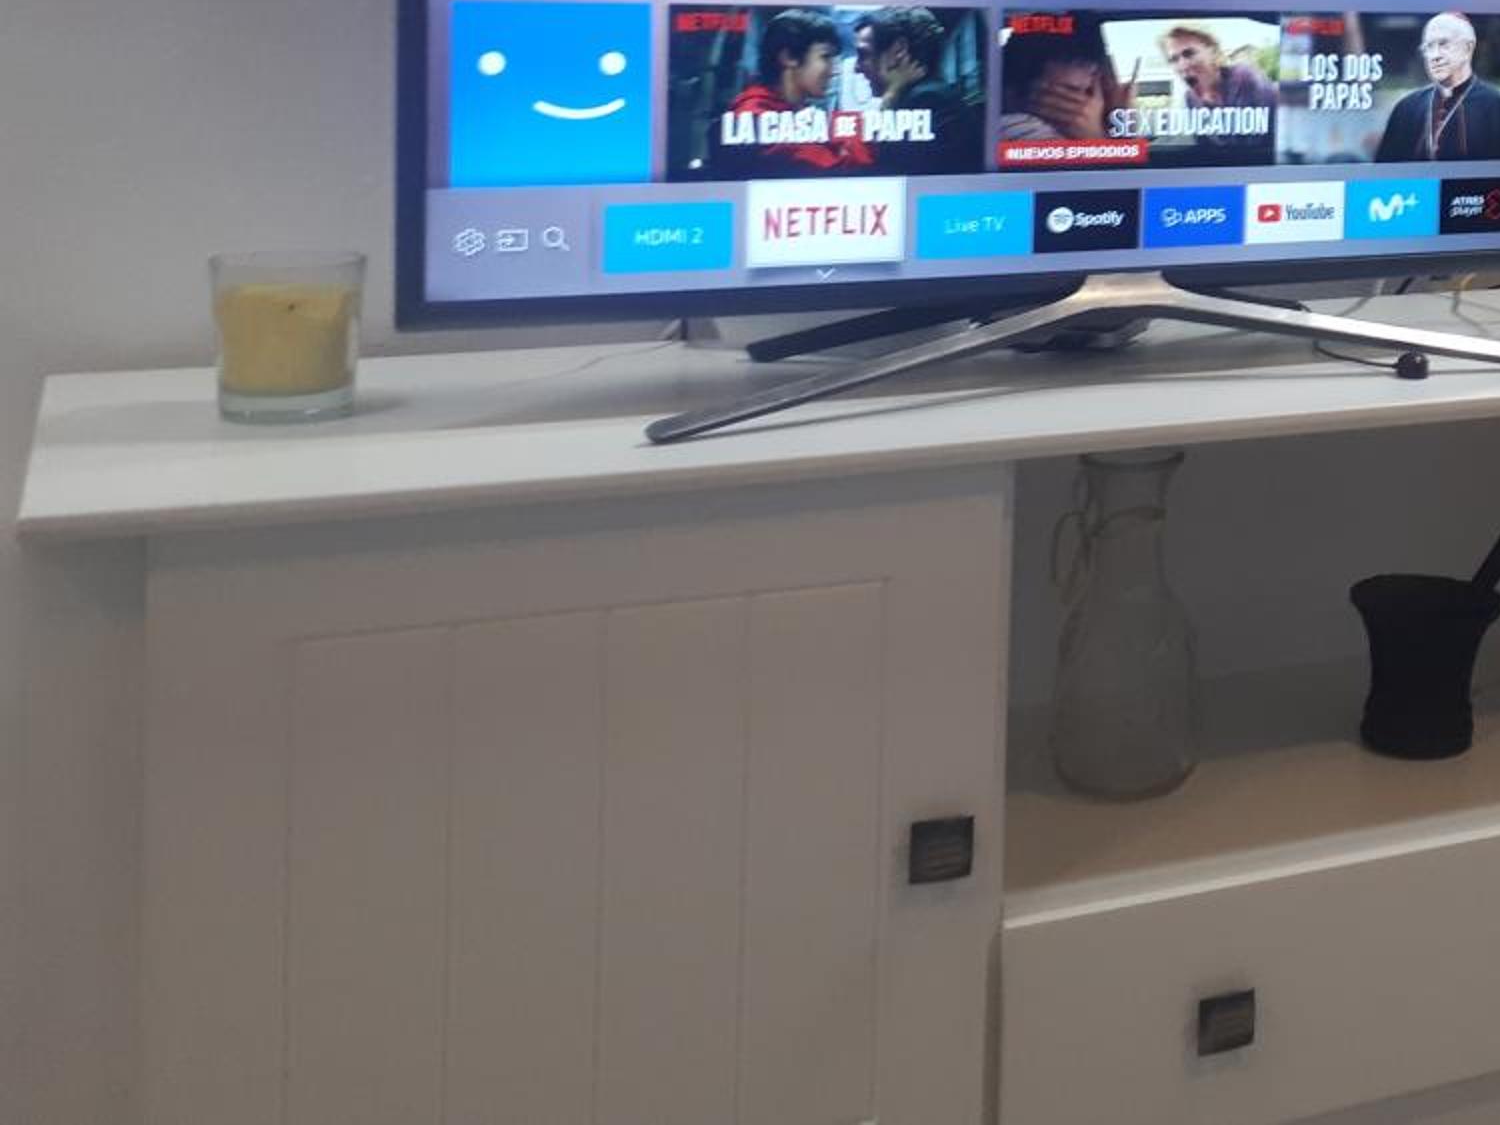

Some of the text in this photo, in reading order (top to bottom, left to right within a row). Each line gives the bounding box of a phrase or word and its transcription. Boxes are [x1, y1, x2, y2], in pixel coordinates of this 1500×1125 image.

[1301, 54, 1383, 82] LOS DOS
[1309, 82, 1373, 110] PAPAS
[721, 111, 756, 145] LA
[758, 106, 829, 144] CASA
[863, 109, 936, 142] PAPEL
[1108, 106, 1270, 138] SEX EDUCATION
[763, 204, 889, 241] NETFLIX
[1072, 210, 1125, 228] Spotify
[1183, 208, 1227, 225] APPS
[1284, 202, 1336, 221] YouTube
[944, 214, 1006, 235] Live TV
[634, 228, 704, 246] HDMI 2
